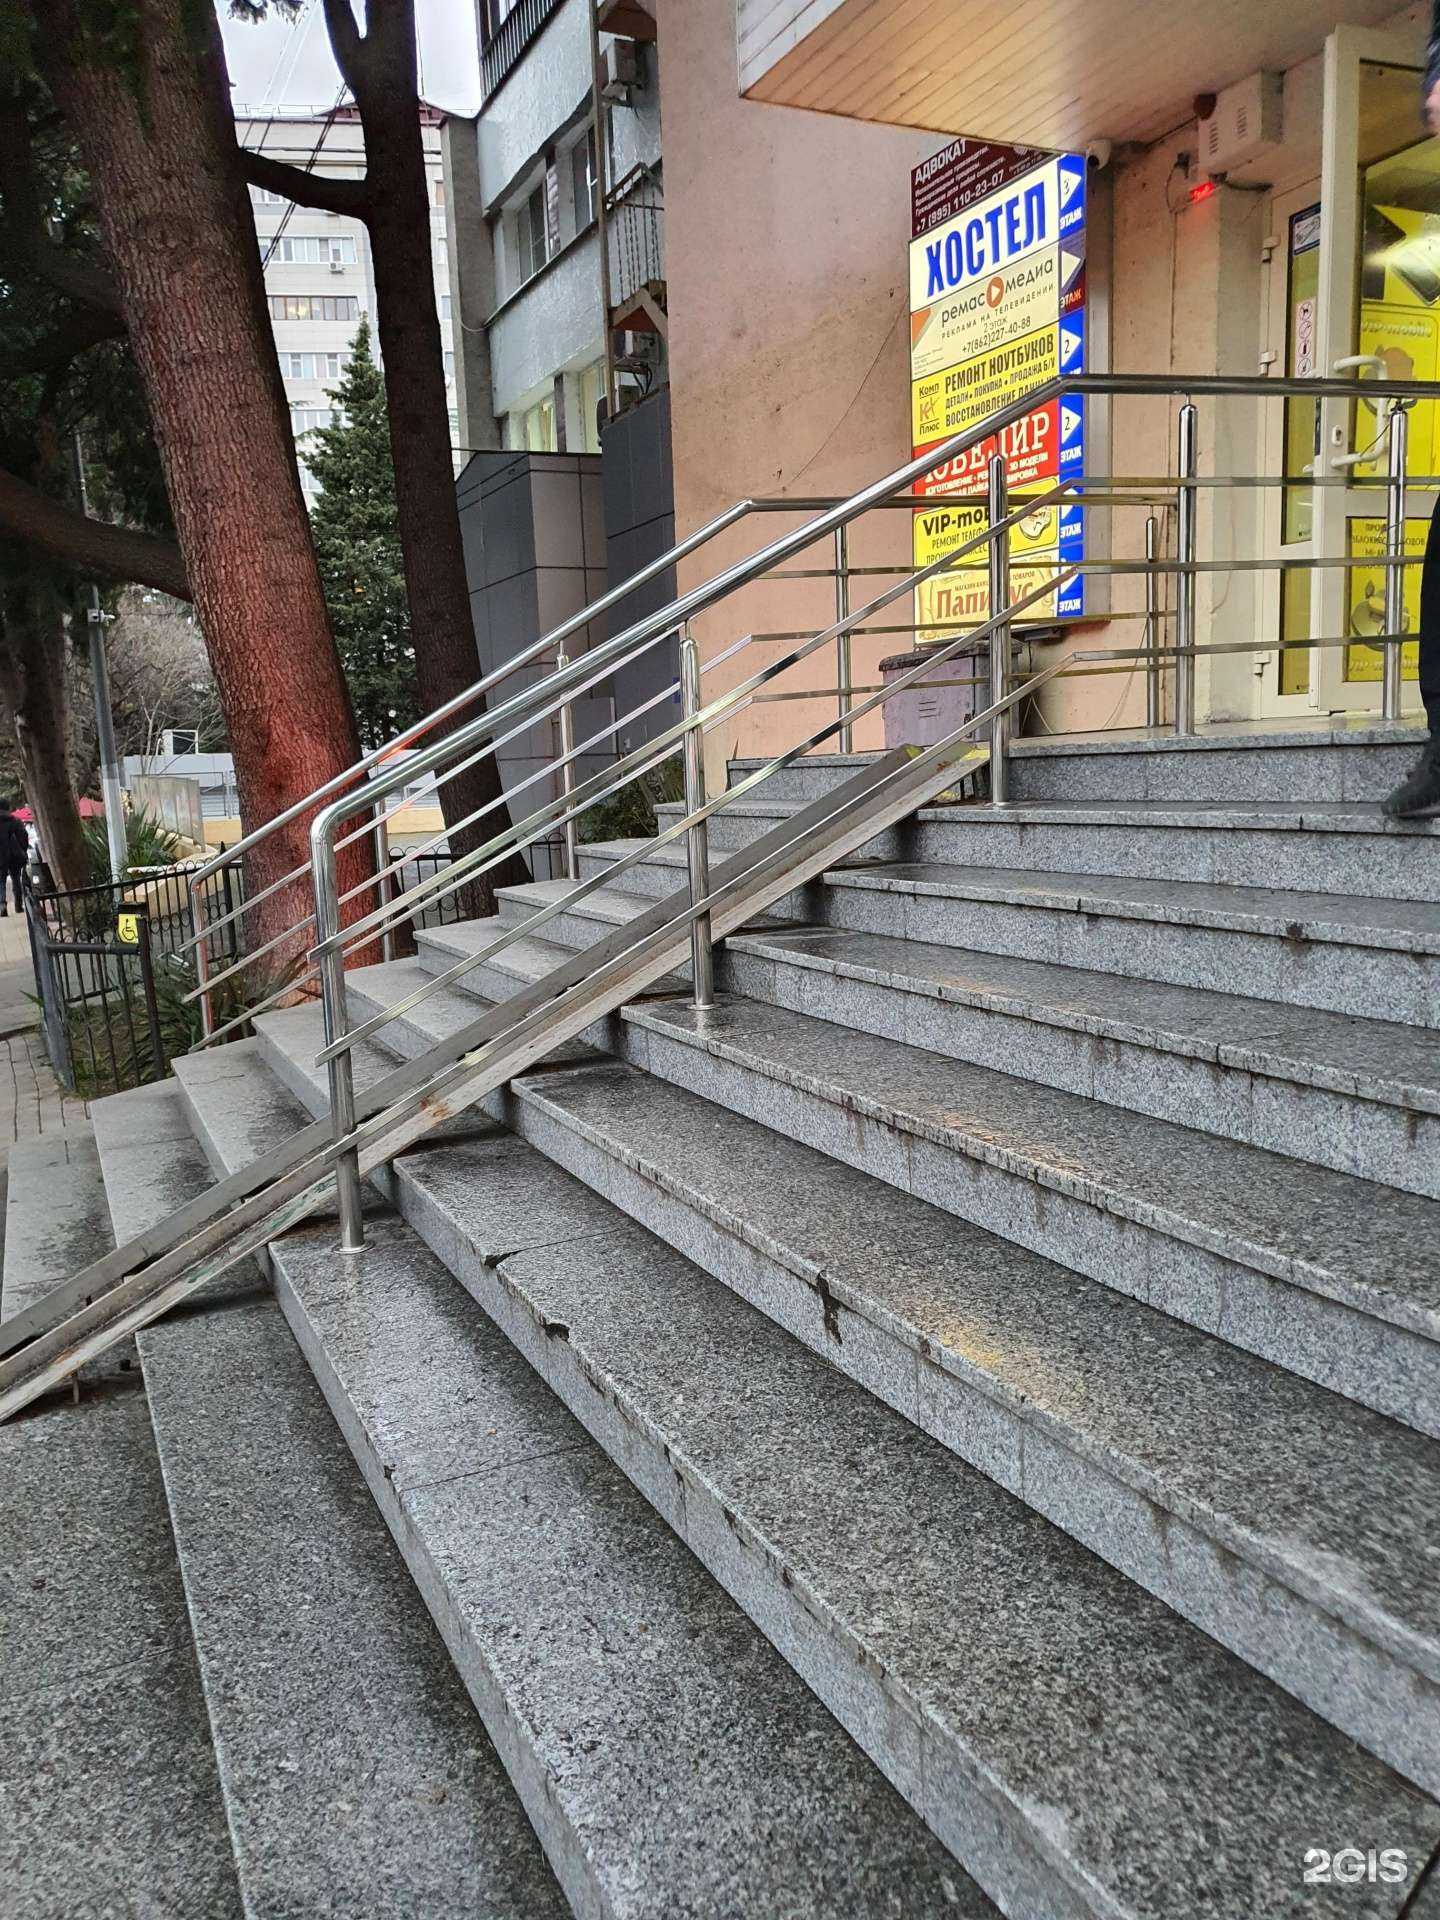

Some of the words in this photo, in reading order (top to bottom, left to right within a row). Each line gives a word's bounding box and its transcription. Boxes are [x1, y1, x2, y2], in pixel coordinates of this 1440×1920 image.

[914, 140, 967, 185] АДВОКАТ
[953, 169, 1005, 210] 110-23-07
[1060, 207, 1082, 230] ЭТАЖ
[925, 182, 1046, 298] ХОСТЕЛ
[941, 292, 986, 328] ремас
[1005, 258, 1054, 294] медиа
[1060, 288, 1082, 308] ЭТАЖ
[941, 319, 977, 340] РЕКЛАМА
[981, 313, 991, 323] НА
[962, 316, 1032, 354] +7(862)227-40-88
[1064, 339, 1070, 354] 2
[945, 359, 987, 394] РЕМОНТ
[989, 333, 1054, 377] НОУТБУКОВ
[919, 383, 940, 396] Комп
[945, 393, 969, 410] ДЕТАЛИ
[974, 378, 1003, 401] ПОКУПКА
[1009, 362, 1042, 385] ПРОДАЖА
[945, 389, 1016, 427] ВОССТАНОВЛЕНИЕ
[919, 421, 940, 435] Плюс
[1064, 416, 1070, 431] 2
[1060, 445, 1082, 463] ЭТАЖ
[931, 532, 960, 549] РЕМОНТ
[1060, 522, 1082, 538] ЭТАЖ
[936, 582, 1033, 619] Папиус
[1059, 598, 1081, 613] ЭТАЖ
